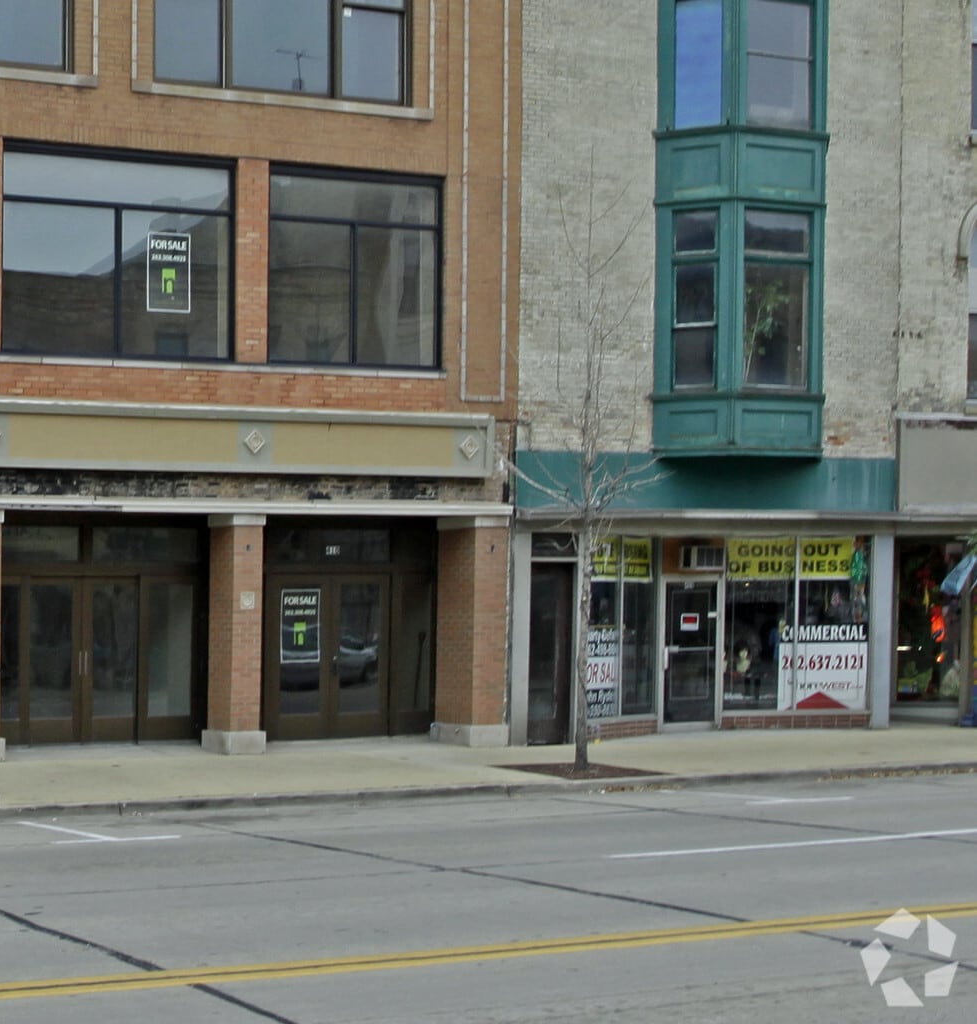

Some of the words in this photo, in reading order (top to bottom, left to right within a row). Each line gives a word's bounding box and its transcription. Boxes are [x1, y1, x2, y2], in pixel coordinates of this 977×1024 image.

[150, 239, 167, 250] FOR
[167, 240, 187, 251] SALE
[737, 544, 794, 557] GOING
[803, 544, 842, 556] OUT
[729, 560, 751, 573] OF
[758, 559, 850, 573] BUSNESS
[284, 596, 299, 606] FOR
[299, 595, 317, 606] SALE
[782, 624, 866, 642] COMMERCIAL
[586, 663, 599, 683] OR
[600, 662, 615, 683] SAL
